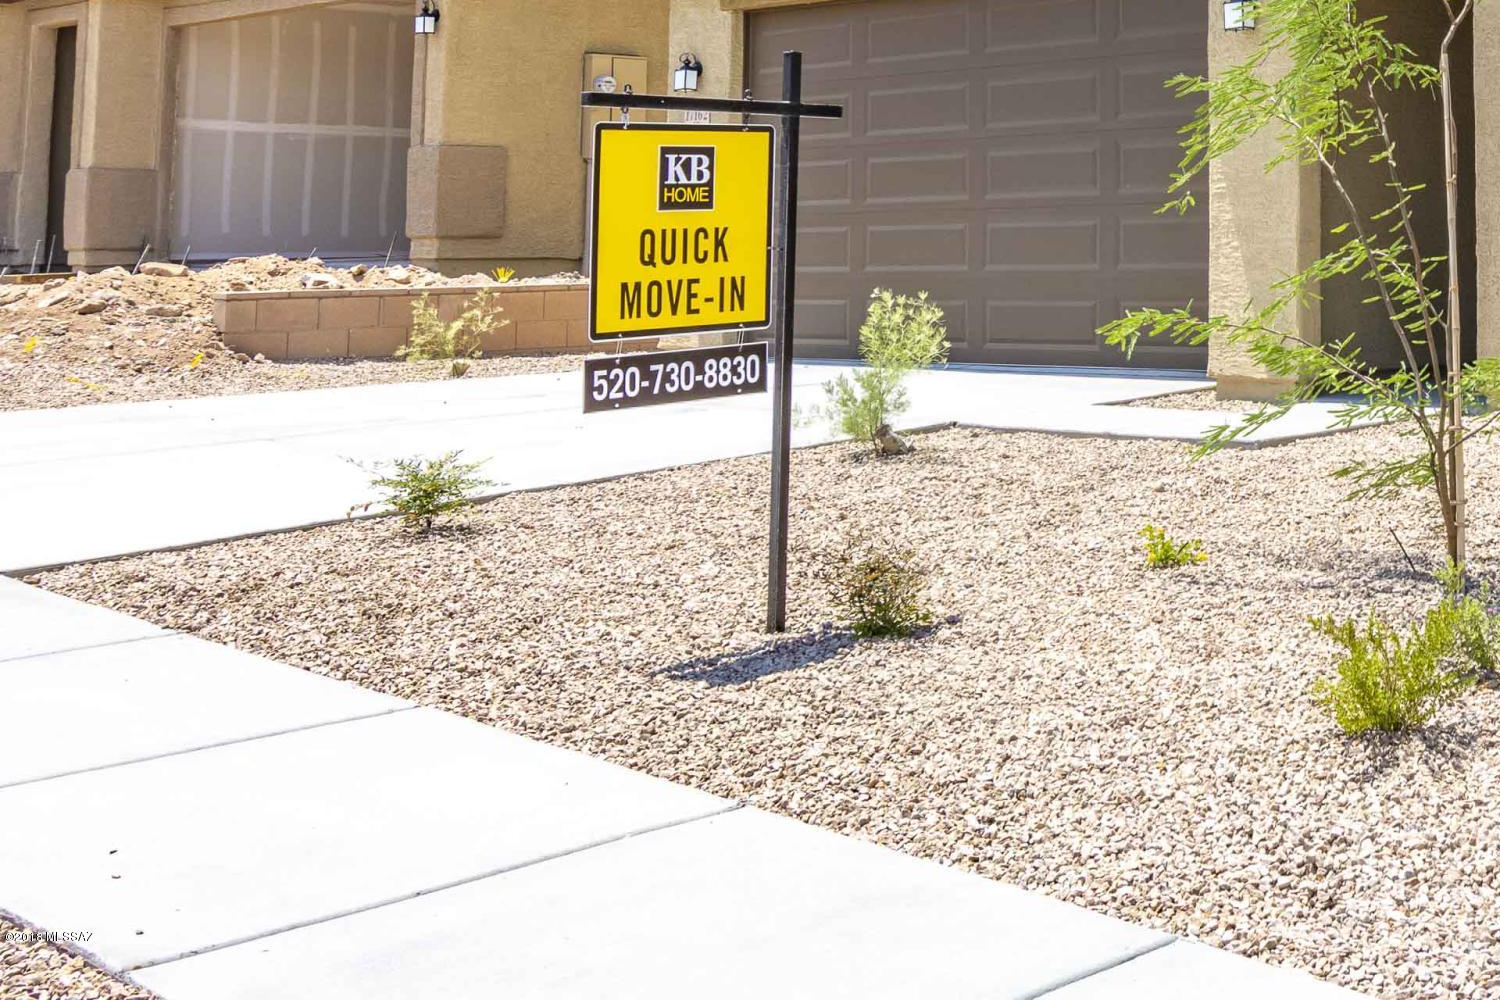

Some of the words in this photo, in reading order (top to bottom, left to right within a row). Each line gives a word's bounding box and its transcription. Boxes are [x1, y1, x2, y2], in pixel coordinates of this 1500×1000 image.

[664, 153, 710, 185] KB
[664, 187, 710, 203] HOME
[639, 227, 729, 268] QUICK
[620, 275, 746, 319] MOVE-IN
[592, 354, 760, 401] 520-730-8830
